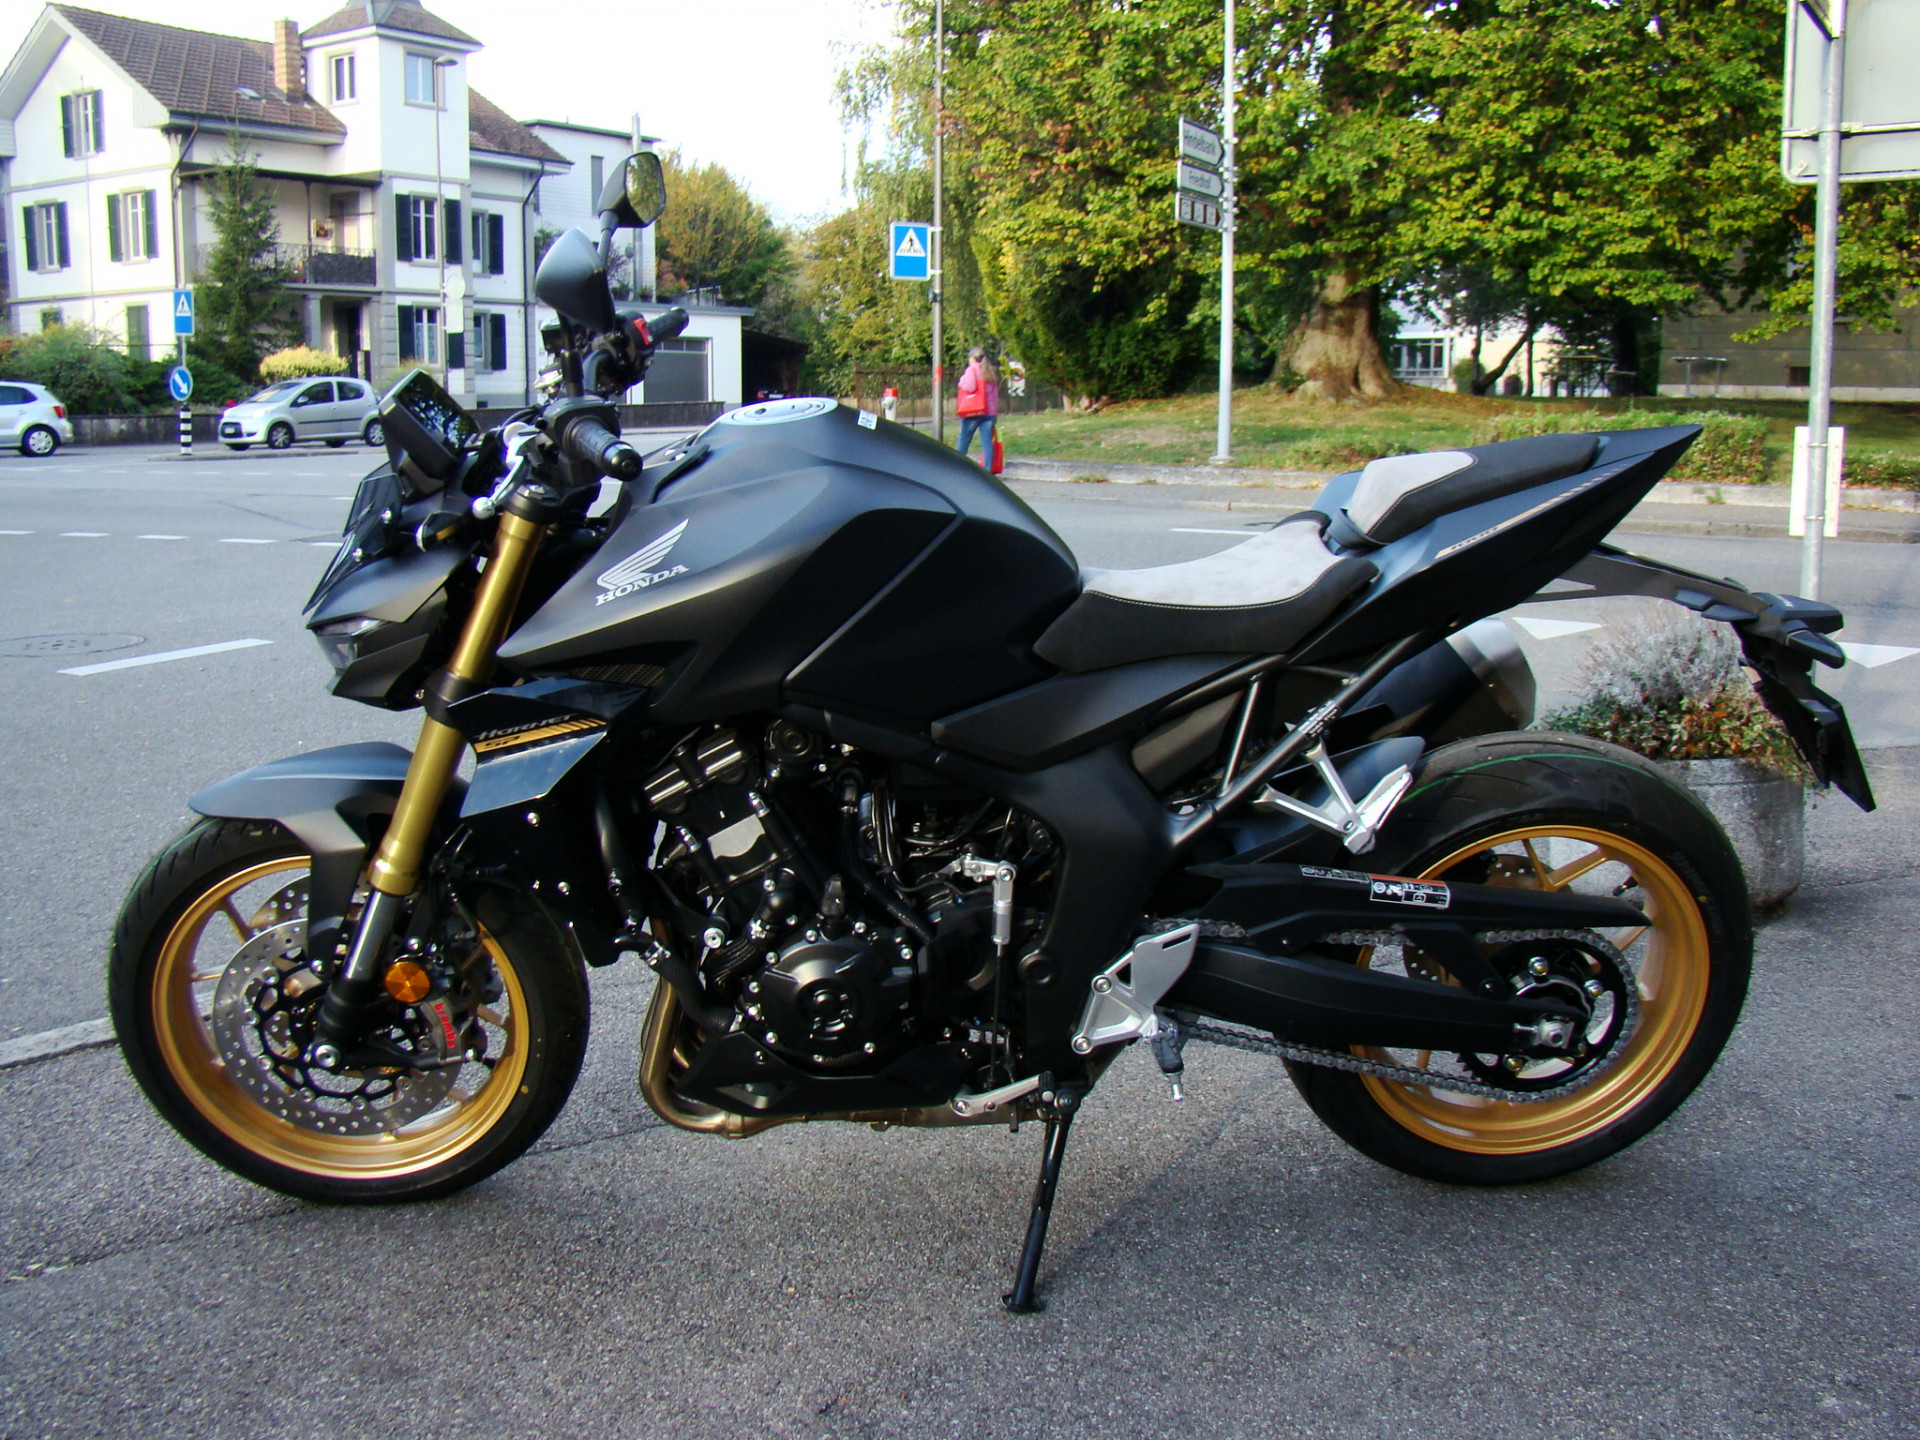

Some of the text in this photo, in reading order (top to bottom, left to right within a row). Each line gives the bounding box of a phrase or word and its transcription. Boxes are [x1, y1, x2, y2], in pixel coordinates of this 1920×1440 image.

[595, 564, 690, 606] HONDA
[485, 735, 521, 749] SP
[434, 1003, 457, 1049] brembo
